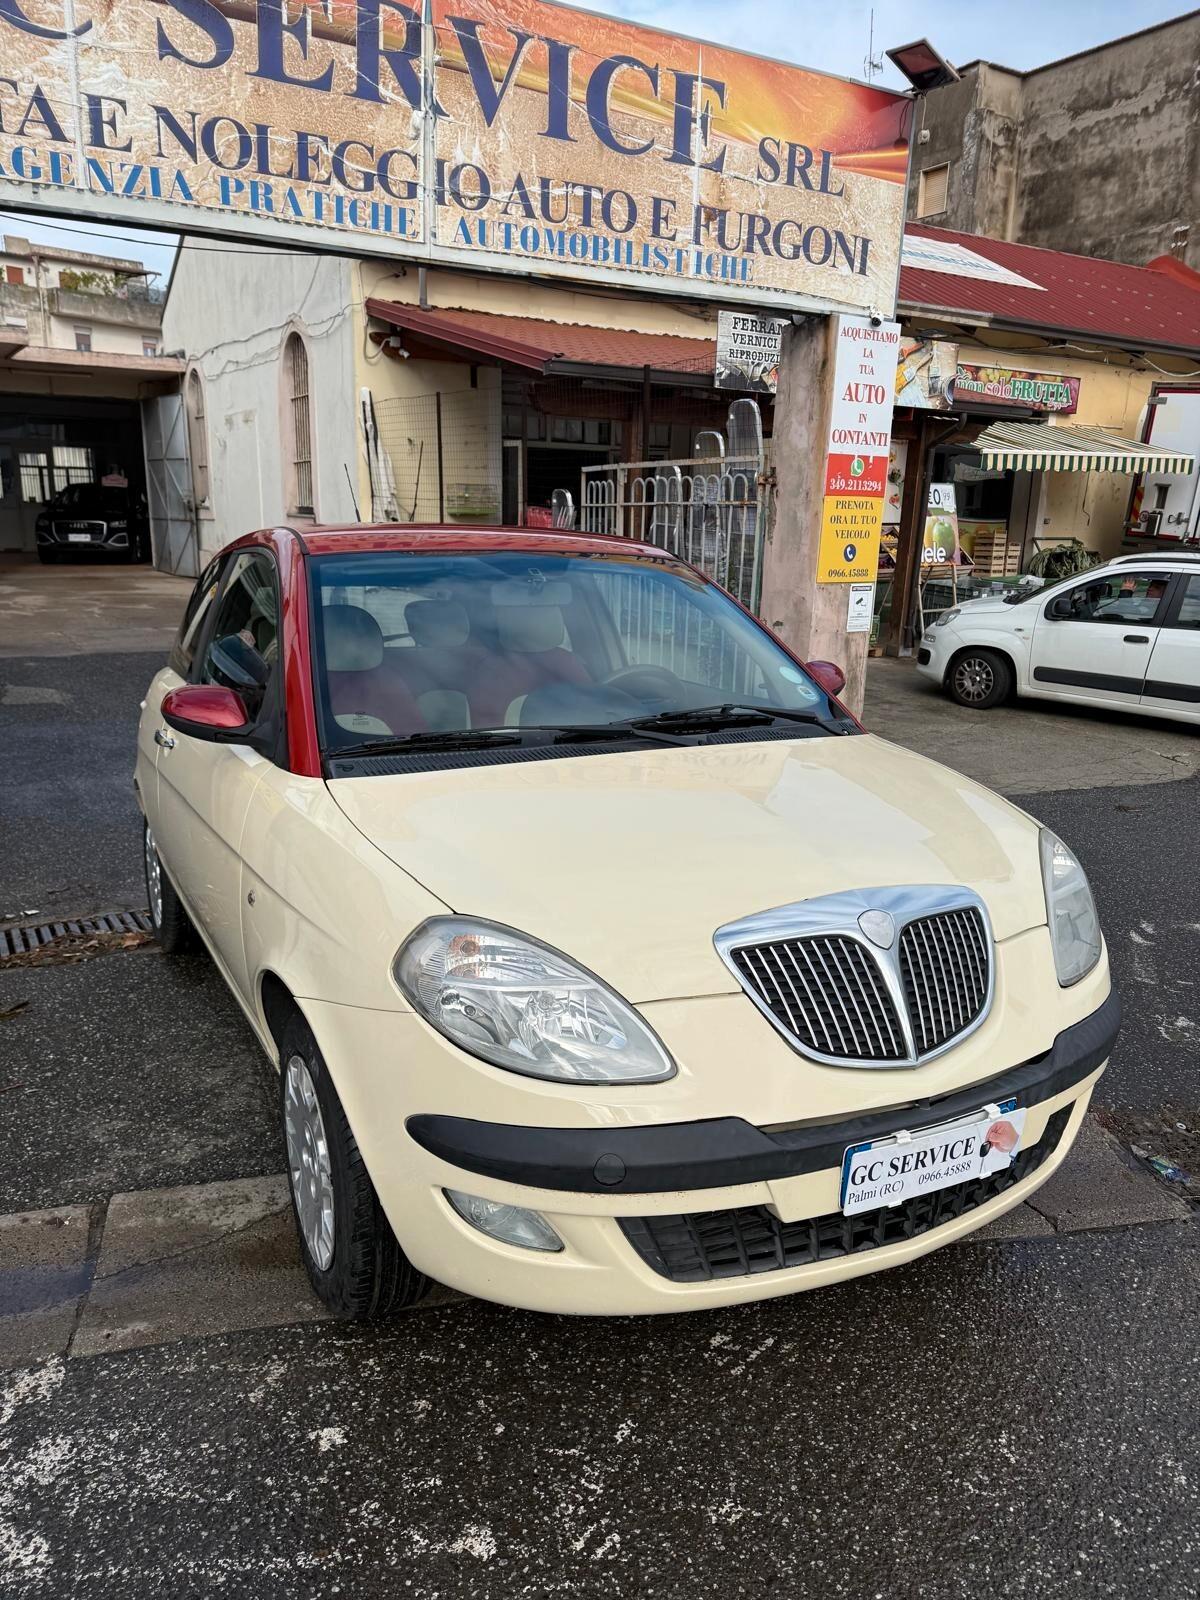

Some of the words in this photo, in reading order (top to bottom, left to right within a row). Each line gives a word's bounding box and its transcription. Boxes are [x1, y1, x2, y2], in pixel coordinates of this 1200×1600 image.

[156, 0, 727, 173] SERVICE
[757, 136, 845, 197] SRL
[80, 92, 133, 152] E
[150, 104, 491, 211] NOLEGGIO
[501, 172, 638, 234] AUTO
[650, 196, 678, 242] E
[692, 204, 873, 278] FURGONI
[0, 146, 194, 201] GENZIA
[218, 175, 420, 238] PRATICHE
[453, 215, 755, 282] AUTOMOBILISTICHE
[732, 333, 778, 349] VERNICI
[840, 326, 898, 343] ACQUISTIAMO
[863, 347, 874, 358] LA
[859, 364, 875, 375] TUA
[842, 382, 886, 404] AUTO
[859, 413, 867, 423] IN
[832, 429, 888, 447] CONTANTI
[830, 478, 882, 491] 349.2113294
[835, 500, 874, 510] PRENOTA
[830, 515, 848, 524] ORA
[851, 515, 859, 524] IL
[860, 515, 877, 525] TUO
[835, 529, 870, 539] VEICOLO
[828, 568, 869, 578] 0966.45888
[850, 1161, 885, 1187] GC
[887, 1136, 977, 1178] SERVICE
[848, 1188, 878, 1206] Palmi
[879, 1179, 905, 1199] (RC)
[918, 1160, 972, 1186] 0966.45888
